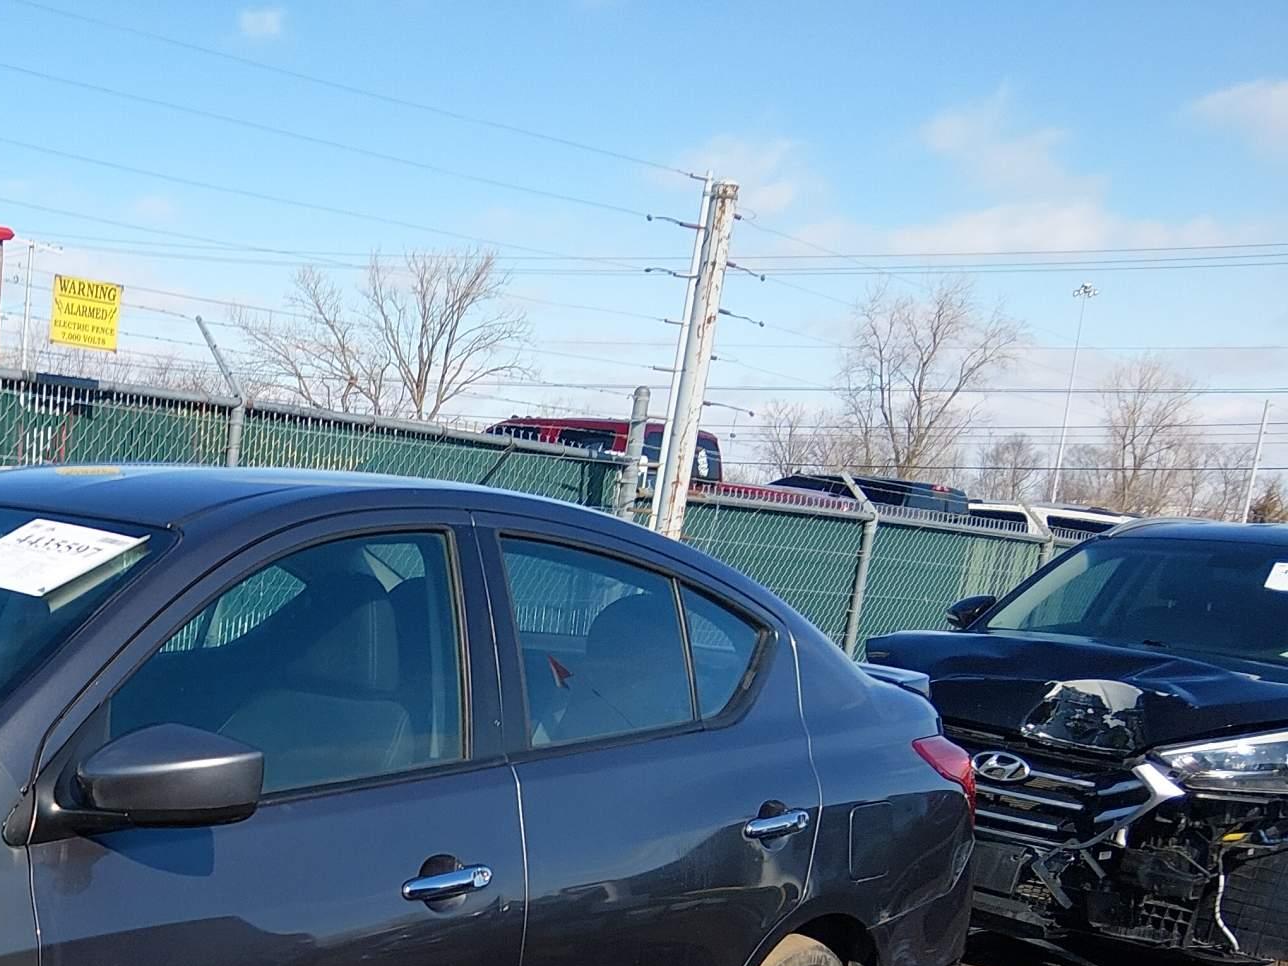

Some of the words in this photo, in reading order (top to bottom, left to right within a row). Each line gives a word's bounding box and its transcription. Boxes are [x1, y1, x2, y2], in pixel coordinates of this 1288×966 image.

[59, 277, 117, 301] WARNING
[64, 302, 108, 321] ALARMED
[54, 319, 90, 332] ELECTRIC
[91, 325, 115, 336] FENCE
[83, 334, 106, 345] VOLTS
